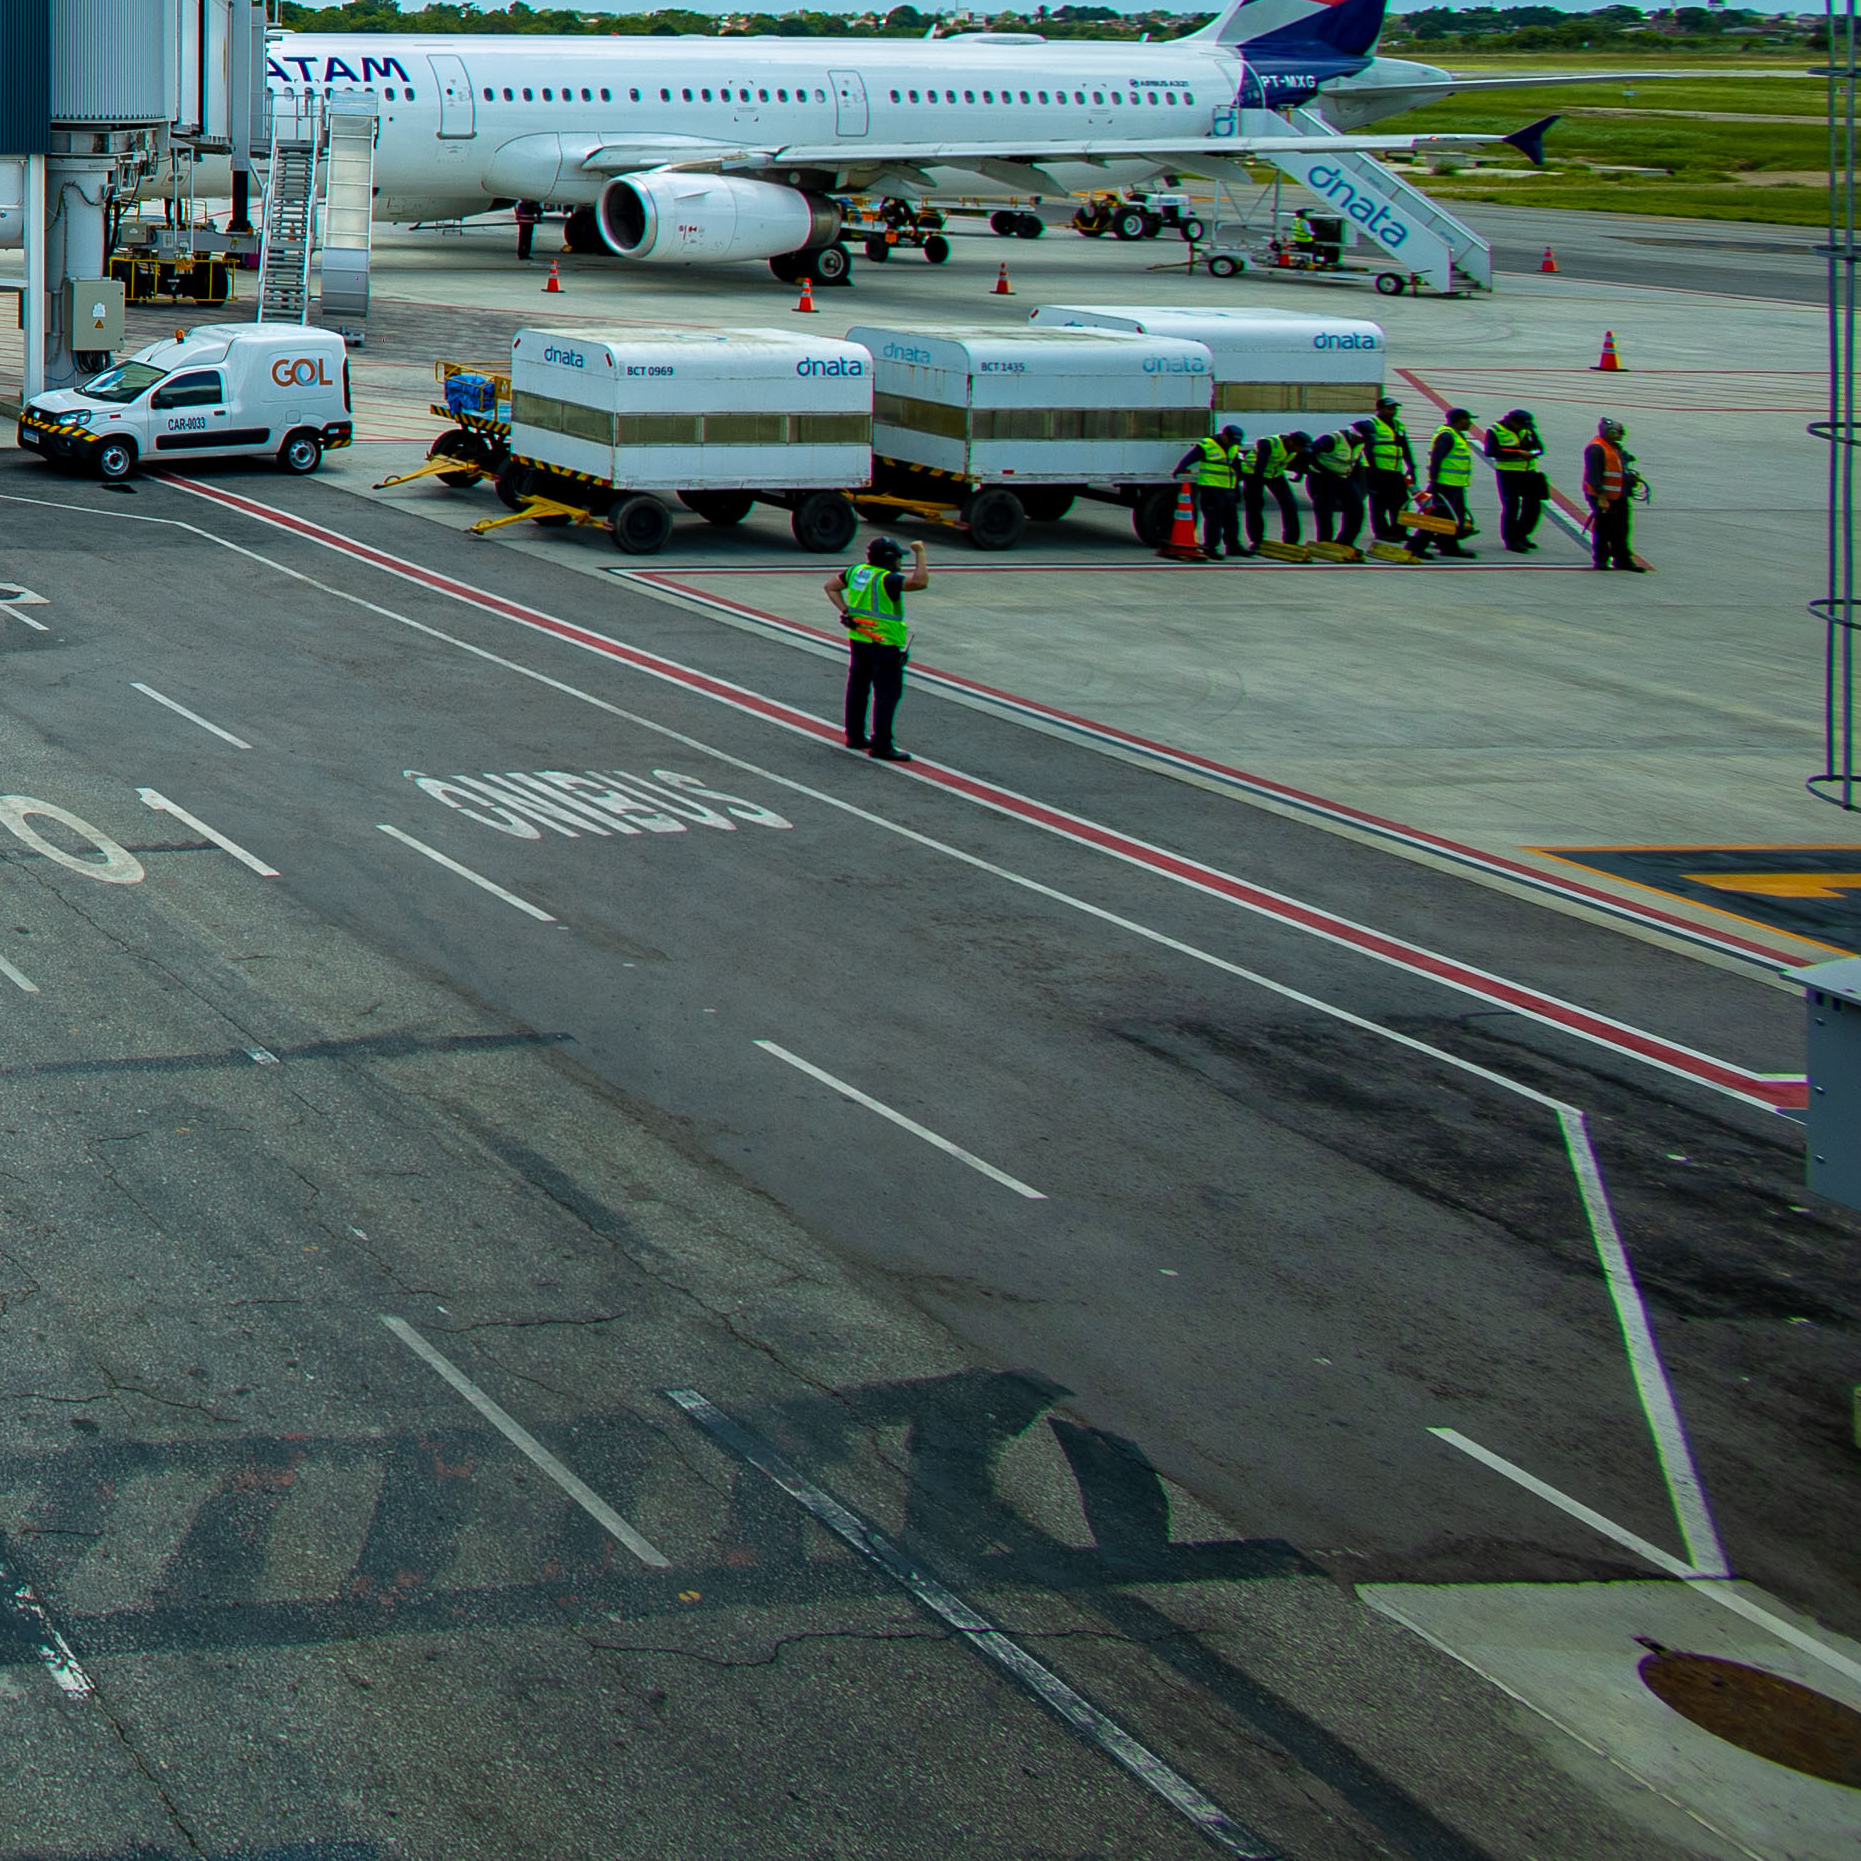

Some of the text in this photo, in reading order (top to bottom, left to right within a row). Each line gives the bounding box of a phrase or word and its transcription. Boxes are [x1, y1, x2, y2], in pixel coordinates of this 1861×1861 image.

[266, 56, 411, 83] ATAM
[1261, 75, 1317, 88] PT-MXG
[1308, 165, 1409, 248] dnata
[1314, 332, 1376, 350] dnata
[544, 346, 585, 368] dnata
[883, 342, 931, 364] dnata
[272, 358, 333, 387] GOL
[627, 366, 674, 376] BCT 0969
[796, 356, 864, 377] dnata
[981, 362, 1025, 372] BCT 1435
[1143, 354, 1205, 374] dnata
[168, 416, 206, 431] CAR-0033
